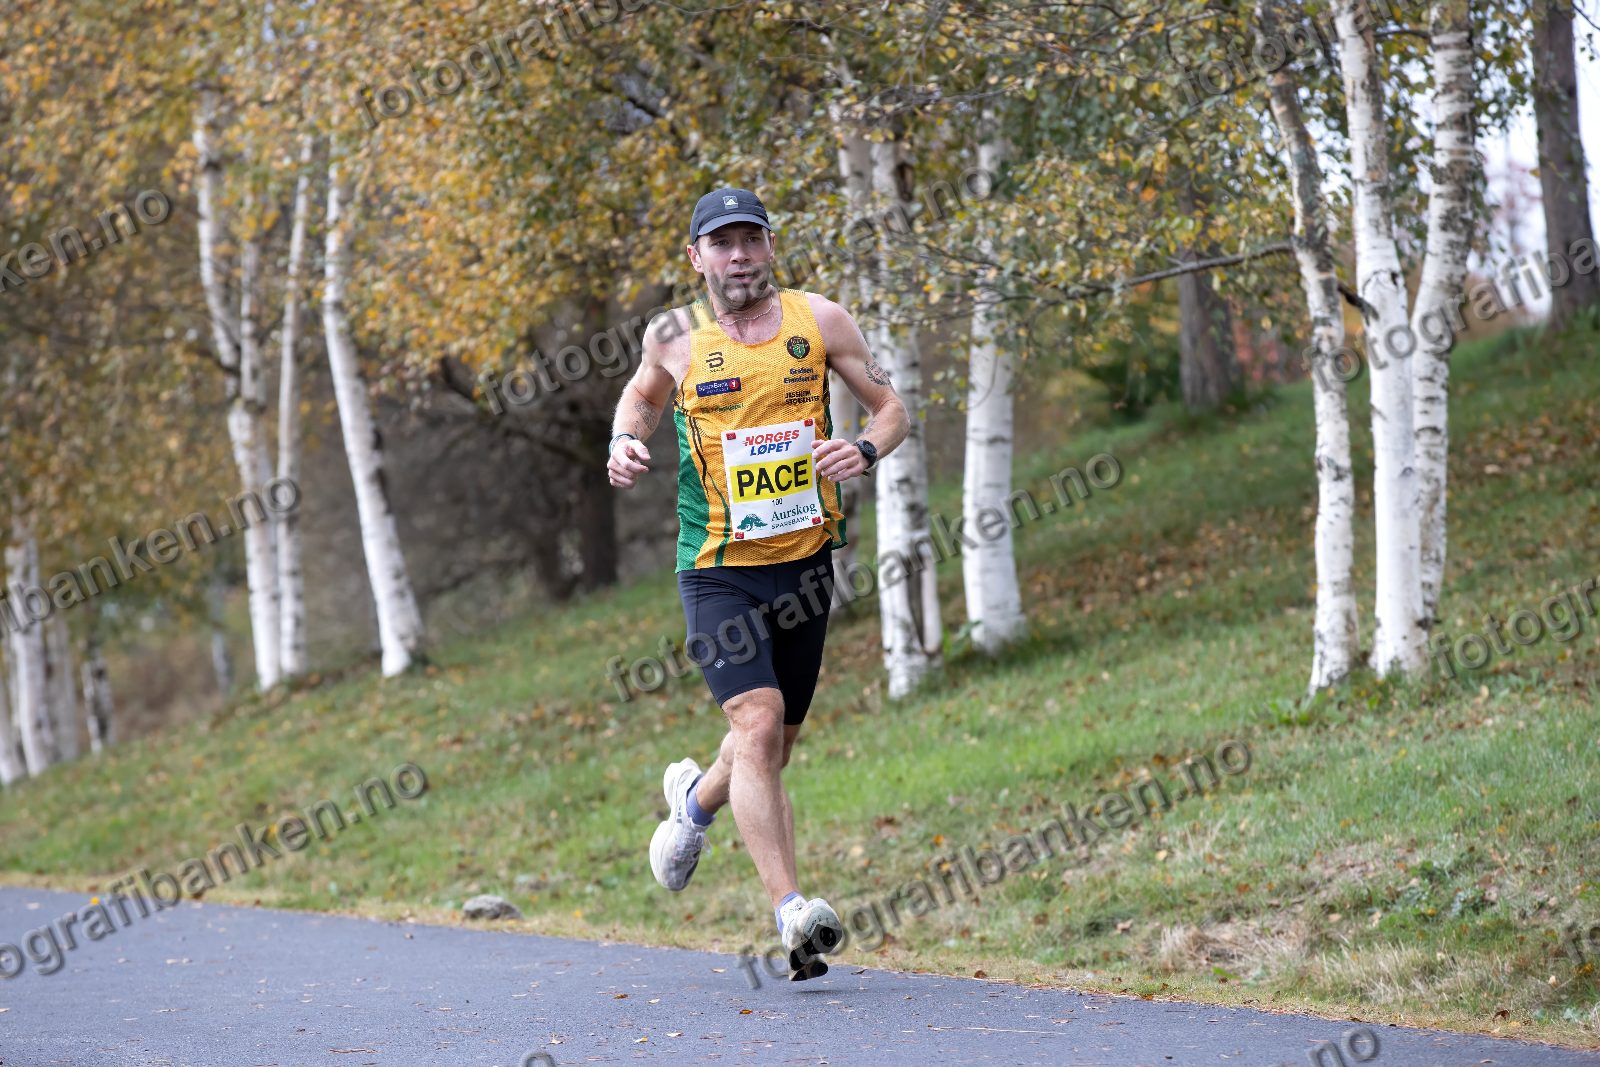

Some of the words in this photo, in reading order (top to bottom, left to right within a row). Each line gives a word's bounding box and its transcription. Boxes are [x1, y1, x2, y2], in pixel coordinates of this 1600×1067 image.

[743, 430, 800, 446] NORGES
[750, 441, 792, 456] LØPET
[737, 459, 809, 497] PACE
[771, 503, 818, 522] Aurskog
[771, 516, 810, 530] SPAREBANK
